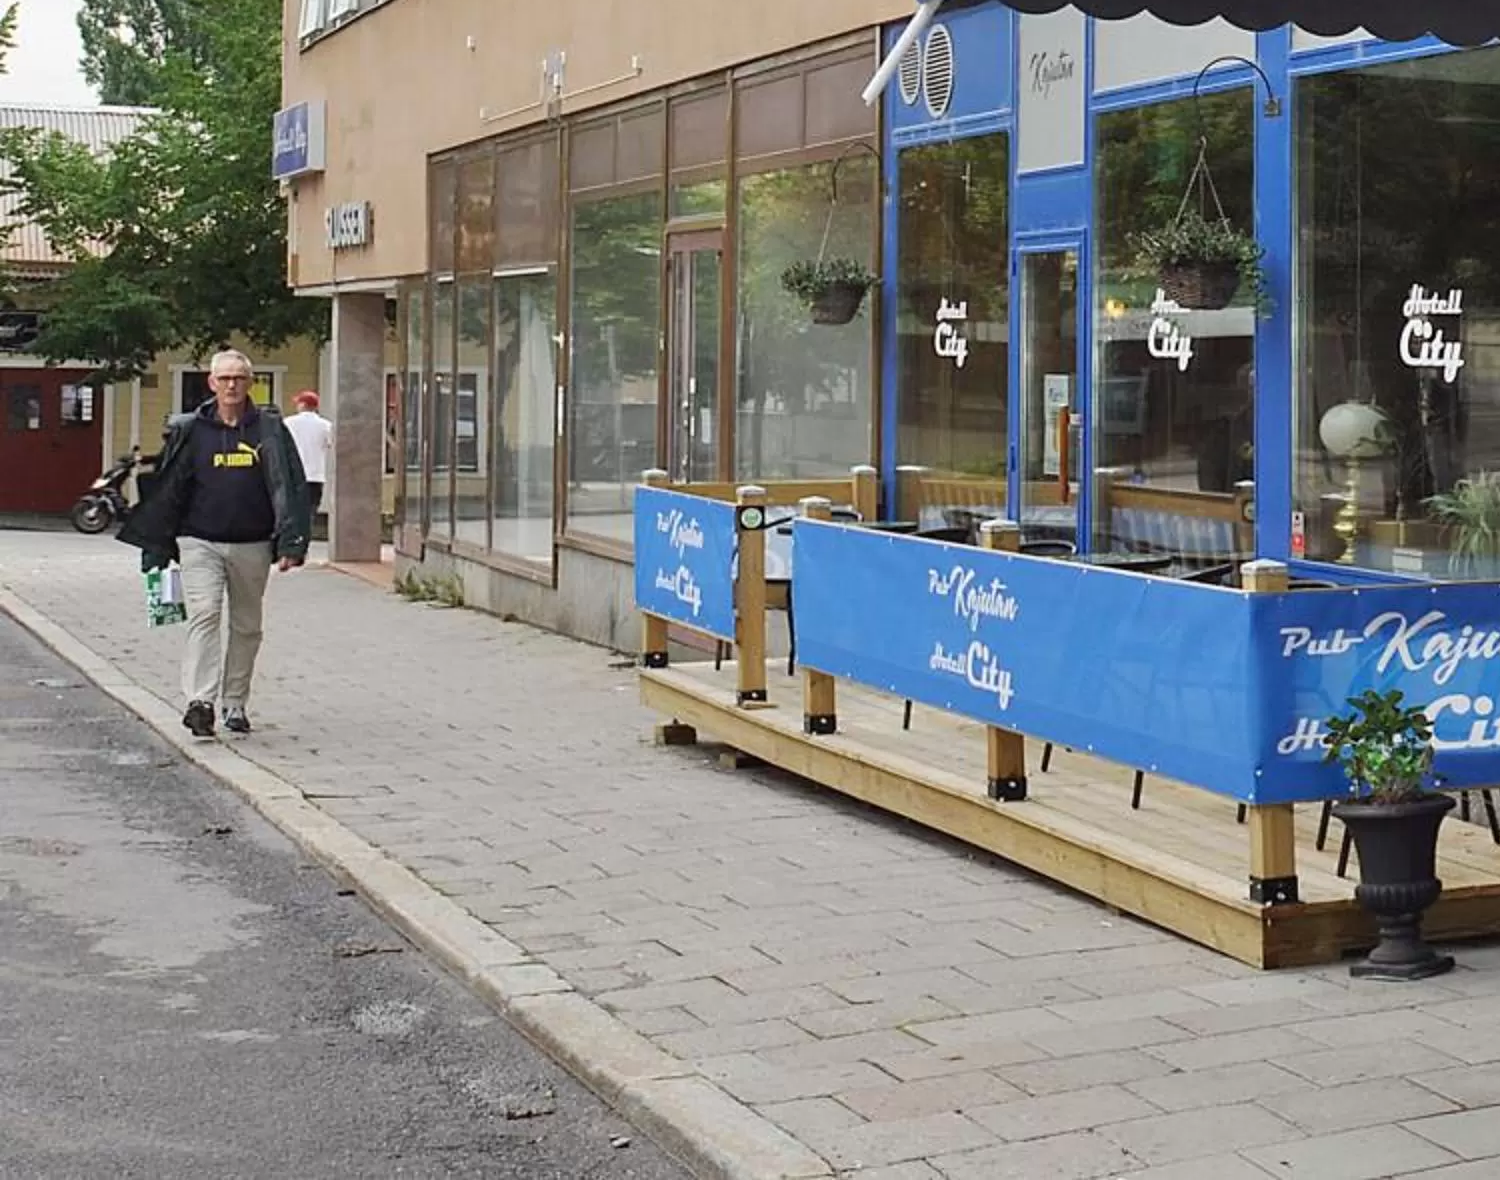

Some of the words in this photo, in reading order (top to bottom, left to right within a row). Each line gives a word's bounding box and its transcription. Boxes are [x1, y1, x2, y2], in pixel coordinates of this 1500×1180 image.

[1029, 50, 1074, 100] Kajutan
[1403, 283, 1463, 317] Hotell
[934, 321, 968, 368] City
[1148, 317, 1193, 372] City
[1400, 319, 1465, 383] City
[675, 564, 702, 617] City
[928, 568, 952, 596] Pub
[949, 564, 1020, 633] Kajutan
[1279, 627, 1364, 657] Pub
[929, 641, 967, 677] Hotell
[967, 639, 1015, 712] City
